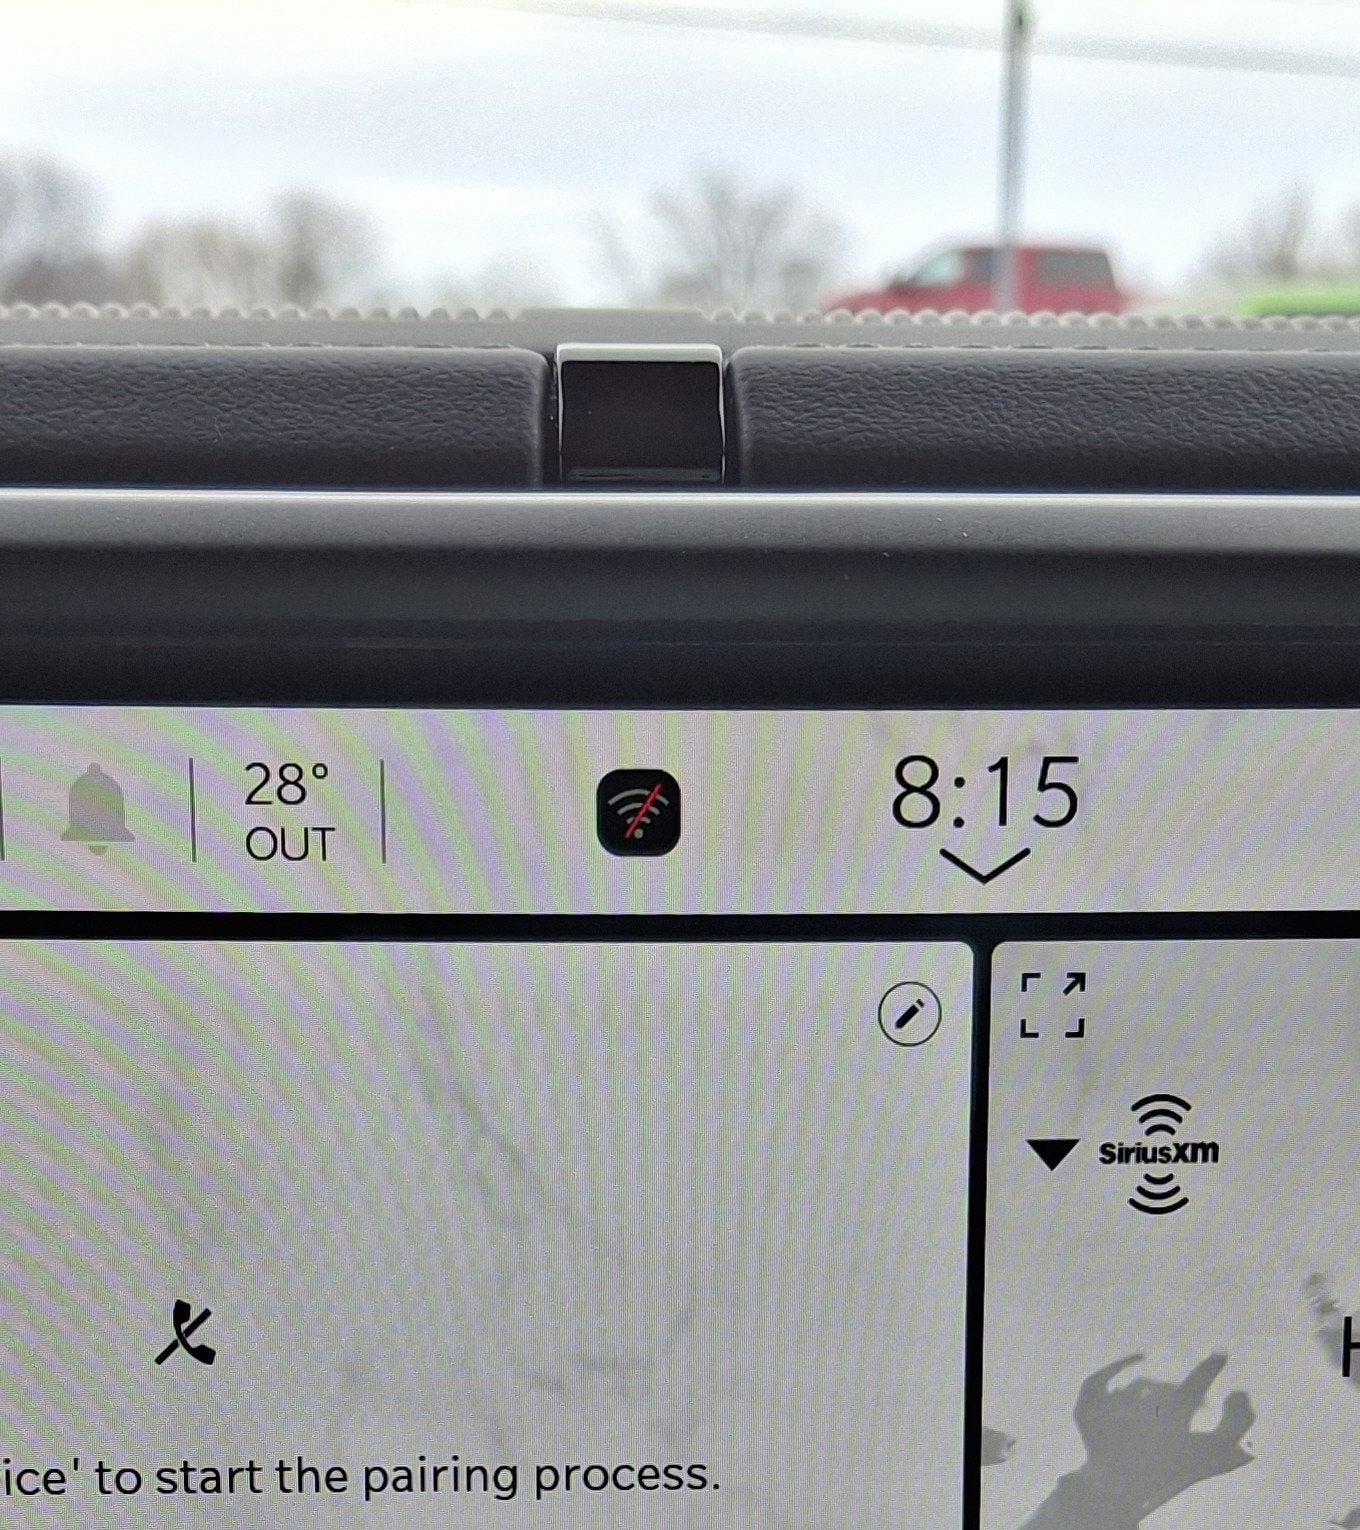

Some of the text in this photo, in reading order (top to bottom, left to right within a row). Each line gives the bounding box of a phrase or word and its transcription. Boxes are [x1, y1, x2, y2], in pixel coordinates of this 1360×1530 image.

[244, 761, 330, 807] 28°
[891, 753, 1080, 830] 8:15
[244, 825, 337, 863] OUT
[93, 1460, 145, 1496] to
[154, 1459, 265, 1496] start
[274, 1454, 349, 1495] the
[363, 1452, 519, 1503] pairing
[533, 1457, 722, 1503] process.
